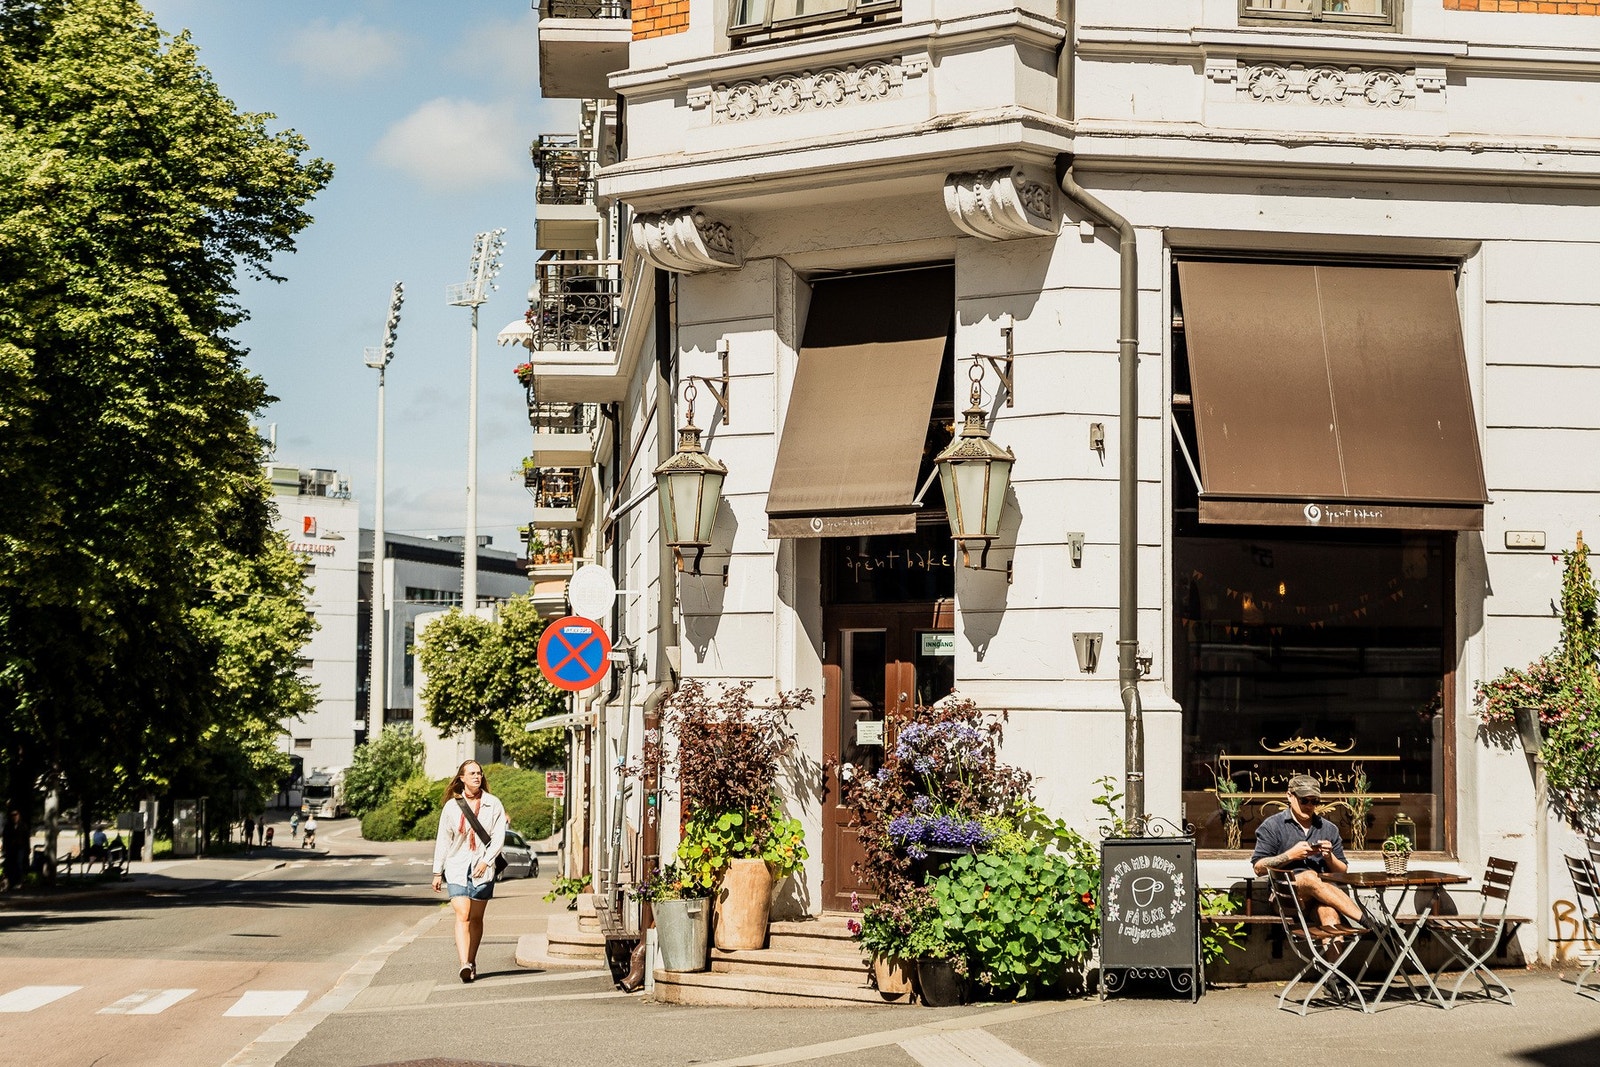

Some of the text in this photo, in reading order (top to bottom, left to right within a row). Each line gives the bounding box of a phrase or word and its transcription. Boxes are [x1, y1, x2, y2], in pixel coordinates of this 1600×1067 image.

[1353, 508, 1383, 520] bakeri
[846, 546, 950, 583] åpent bake
[1114, 861, 1132, 876] TA
[1130, 855, 1151, 870] MED
[1125, 908, 1140, 926] FÅ
